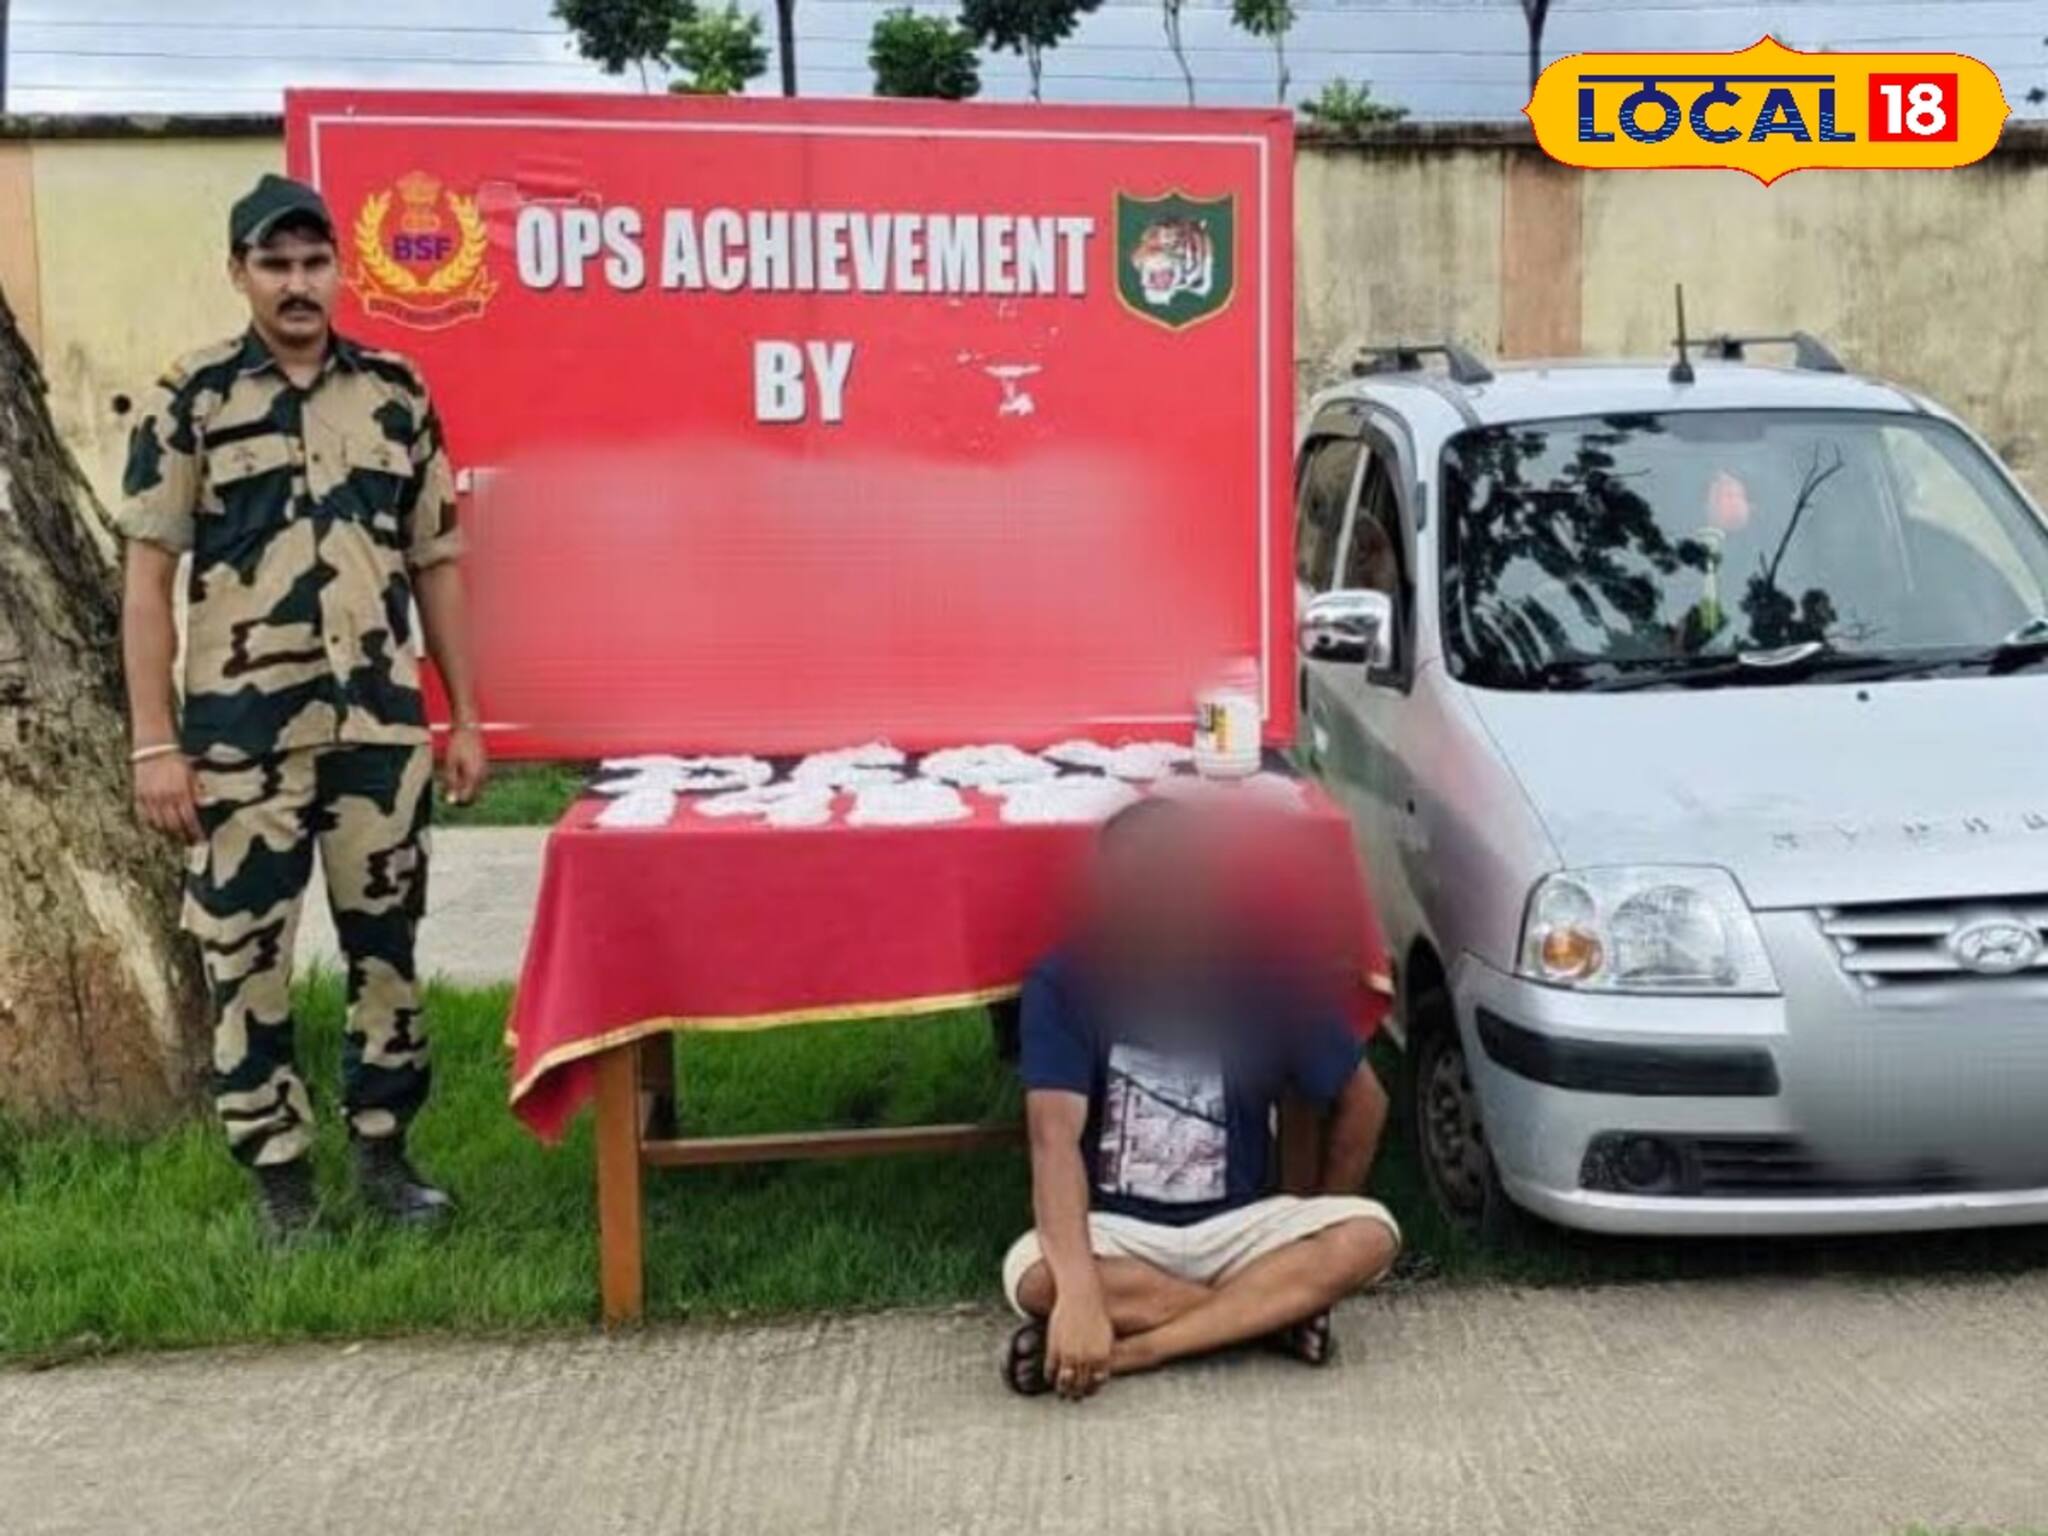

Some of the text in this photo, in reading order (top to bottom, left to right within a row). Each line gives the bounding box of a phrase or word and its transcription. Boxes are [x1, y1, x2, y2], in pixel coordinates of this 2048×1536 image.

[393, 236, 452, 261] BSF
[516, 206, 1093, 297] OPS ACHIEVEMENT
[754, 340, 854, 424] BY
